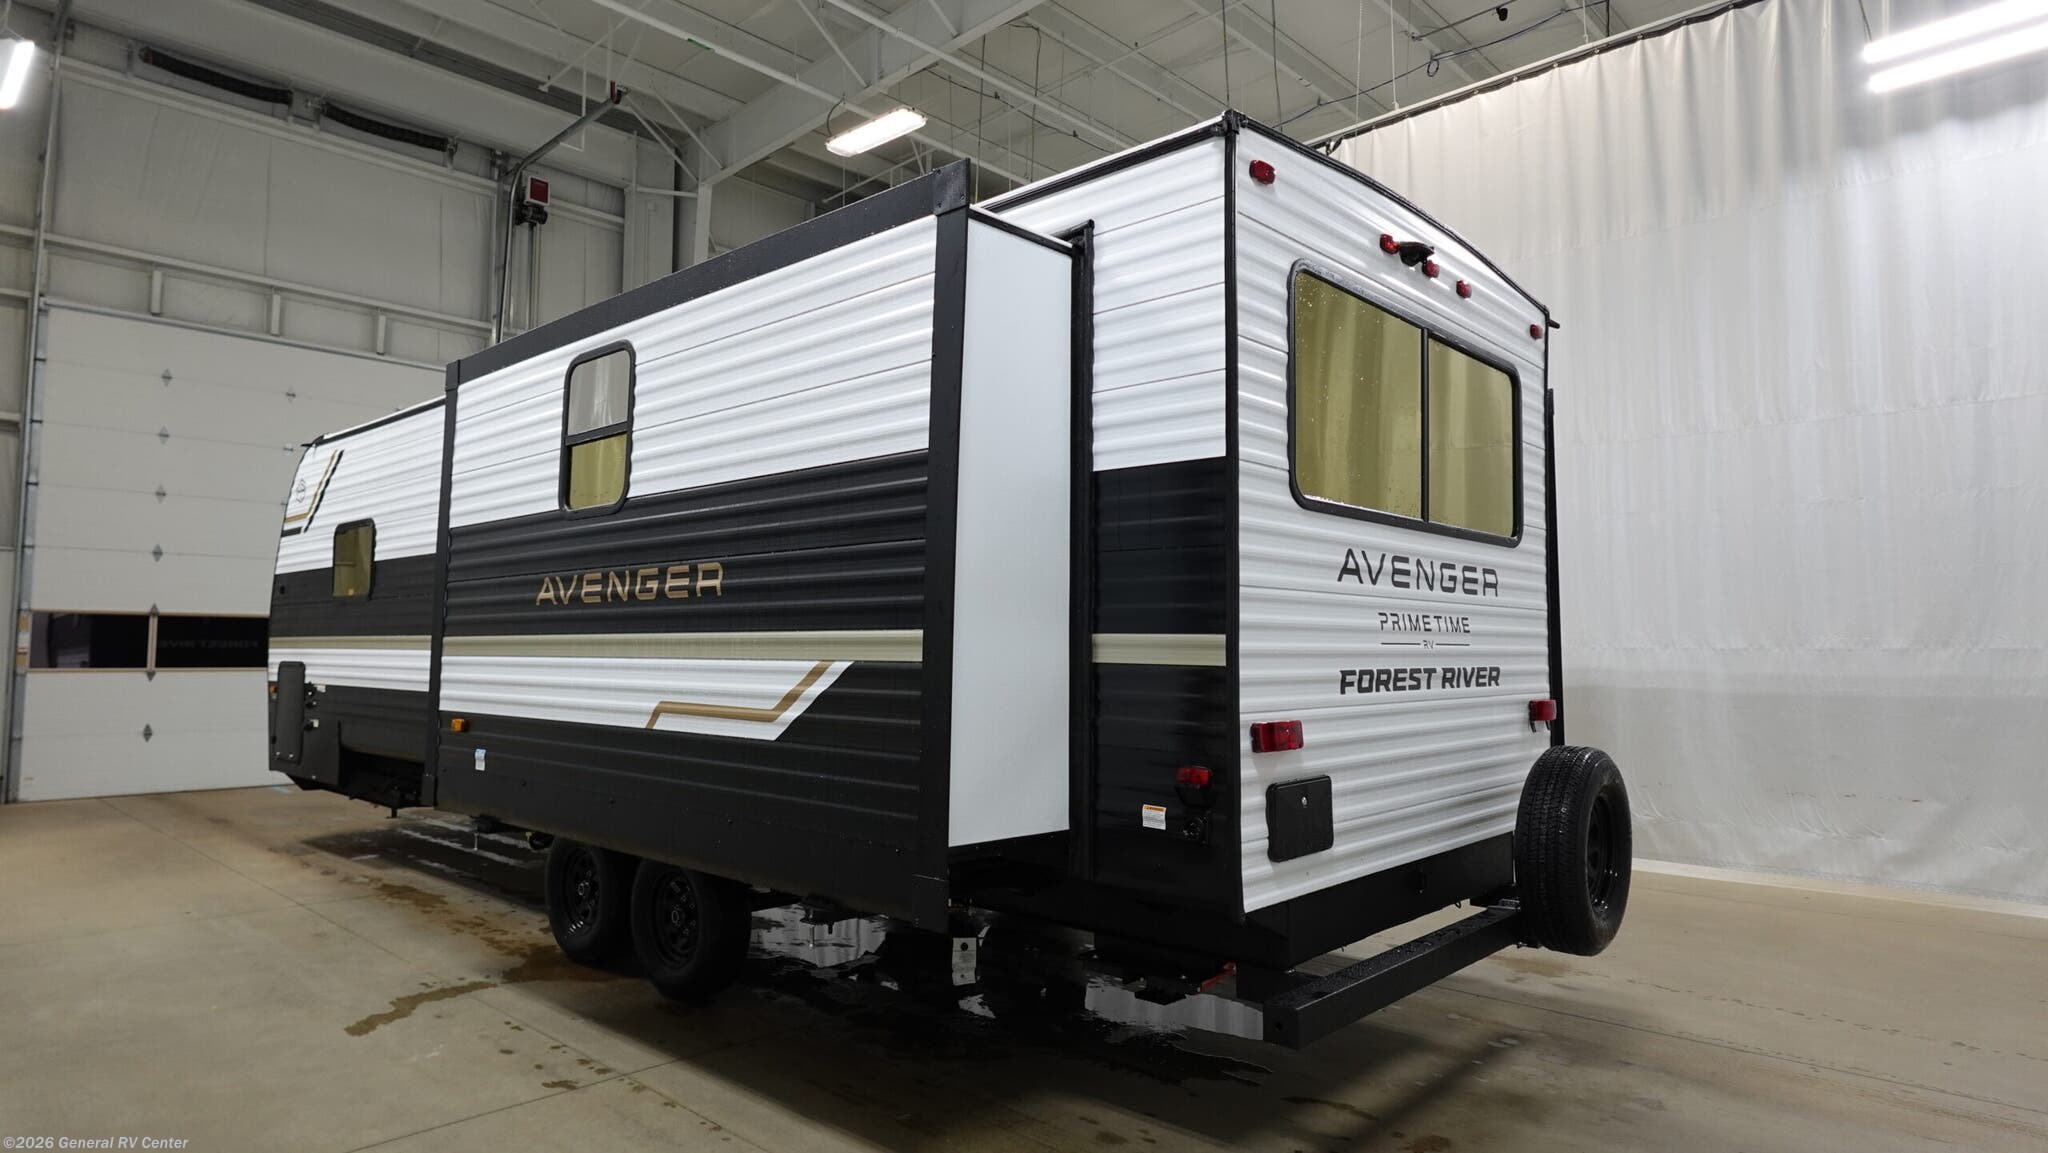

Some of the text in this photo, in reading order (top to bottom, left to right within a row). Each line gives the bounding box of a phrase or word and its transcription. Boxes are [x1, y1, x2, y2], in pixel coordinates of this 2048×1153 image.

[536, 562, 724, 606] AVENGER
[1337, 548, 1499, 597] AVENGER
[1423, 640, 1435, 650] RV
[1340, 666, 1501, 695] FOREST RIVER
